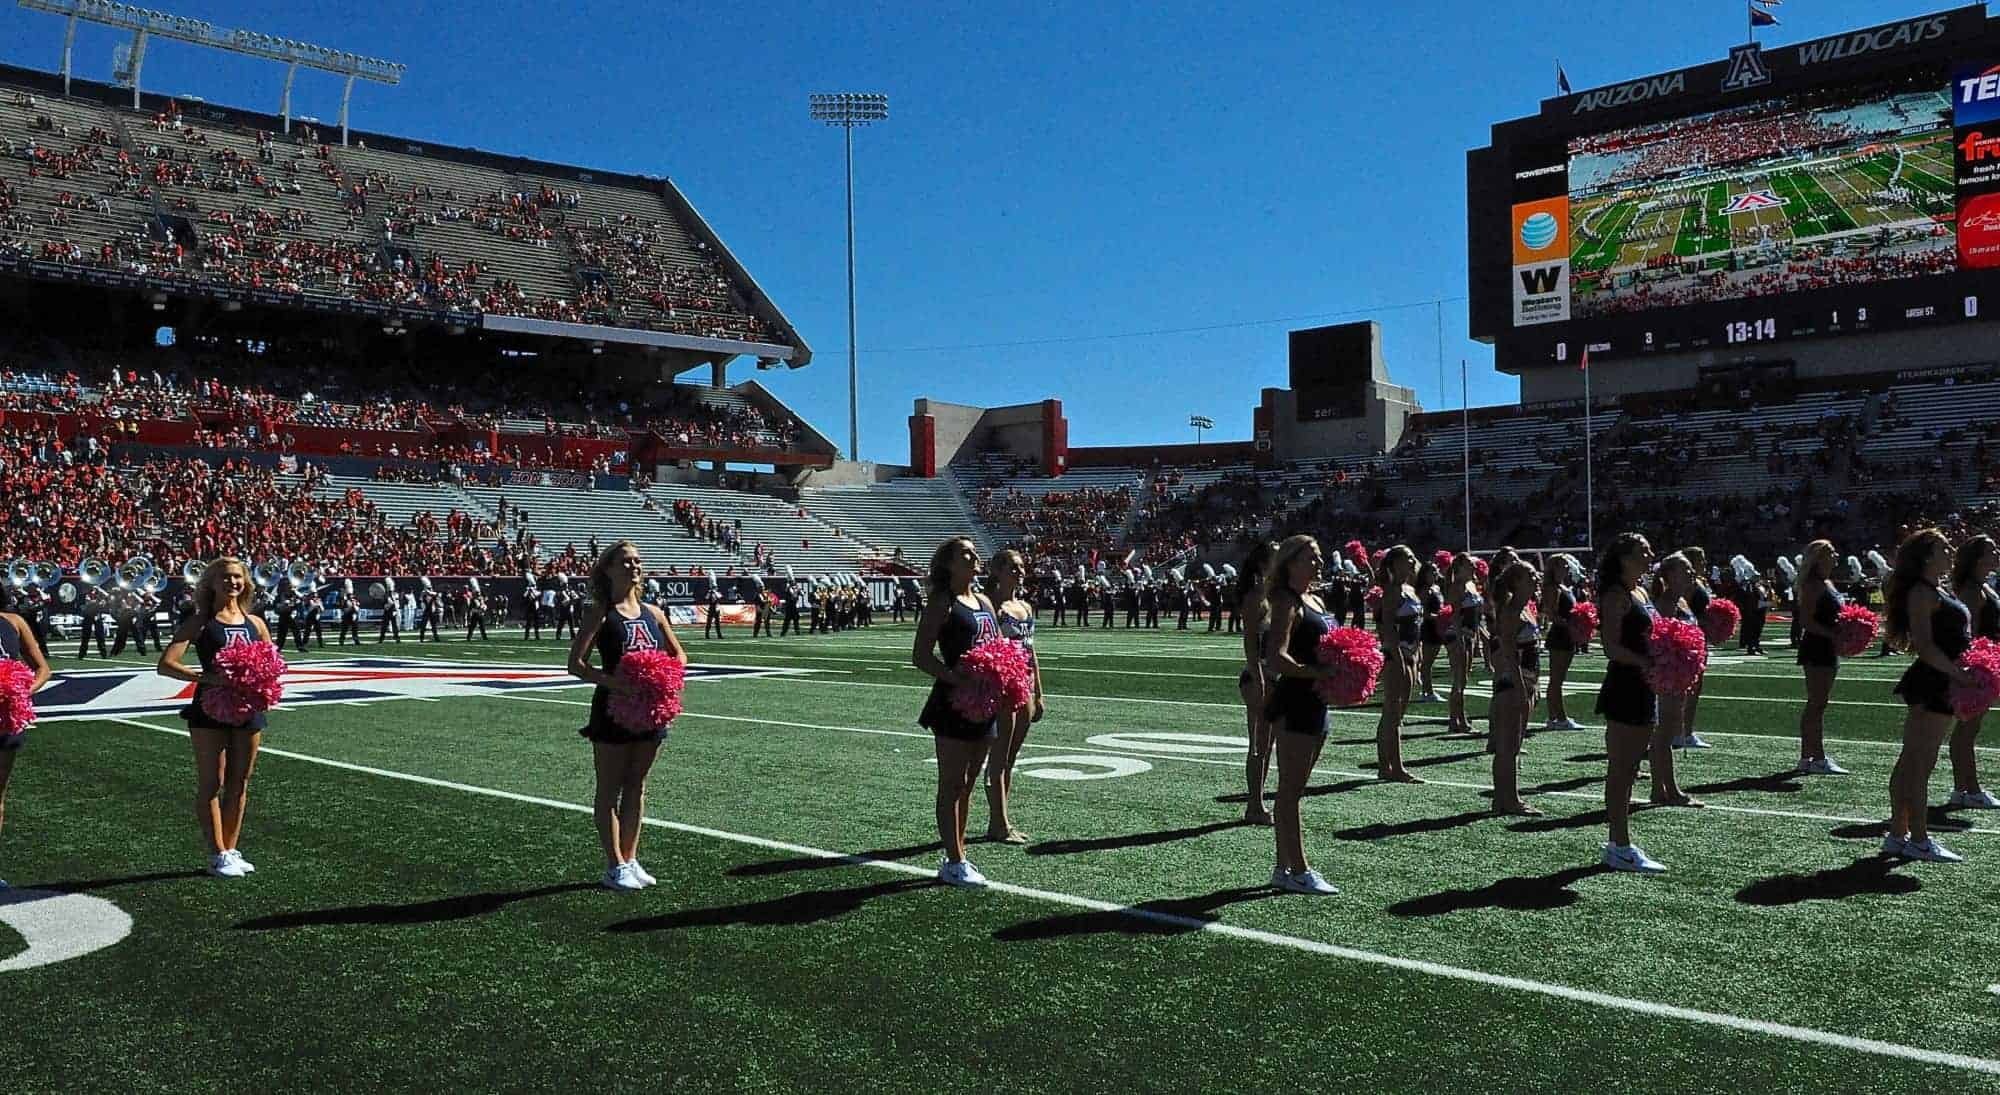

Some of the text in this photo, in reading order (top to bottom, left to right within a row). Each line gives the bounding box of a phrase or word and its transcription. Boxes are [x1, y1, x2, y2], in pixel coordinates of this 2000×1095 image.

[1799, 16, 1948, 66] WILDCATS
[1721, 42, 1772, 92] A
[1572, 73, 1685, 115] ARIZONA
[1960, 73, 2000, 104] TE
[1520, 266, 1562, 296] W
[1832, 311, 1838, 324] 1
[1858, 308, 1867, 321] 3
[1964, 296, 1978, 318] 0
[1645, 332, 1653, 345] 3
[1725, 318, 1776, 344] 13:14
[1556, 342, 1566, 361] 0
[666, 582, 694, 597] SOL
[623, 620, 658, 653] A
